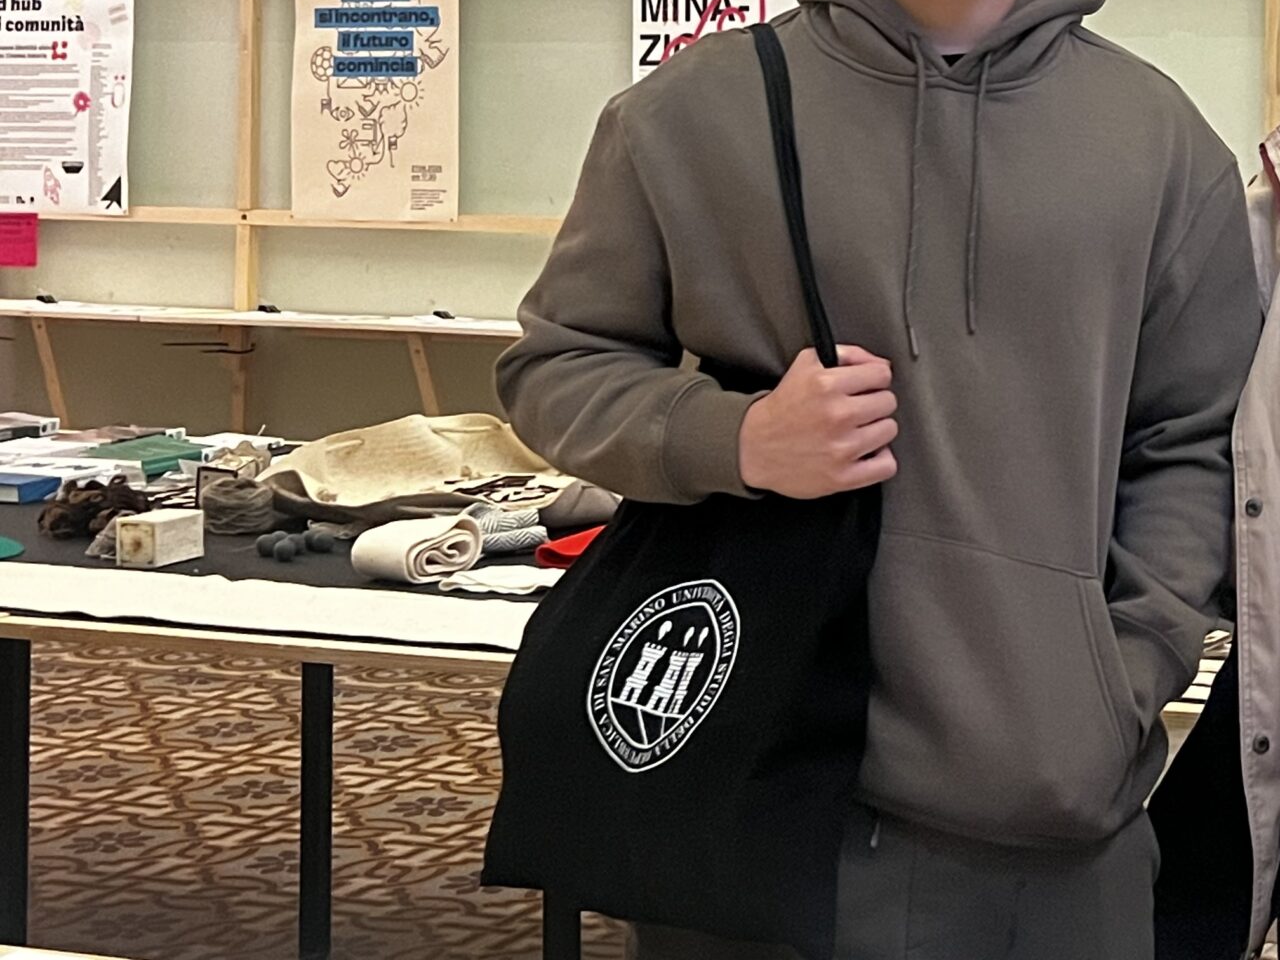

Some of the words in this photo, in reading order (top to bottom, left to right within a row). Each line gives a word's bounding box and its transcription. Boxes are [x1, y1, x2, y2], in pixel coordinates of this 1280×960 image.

[6, 15, 85, 32] comunità
[335, 8, 435, 26] incontrano,
[353, 33, 410, 48] futuro
[335, 58, 417, 74] comincia
[613, 598, 666, 650] MARINO
[718, 611, 737, 658] DEGLI
[596, 656, 616, 687] SAN
[697, 663, 729, 713] STUDI
